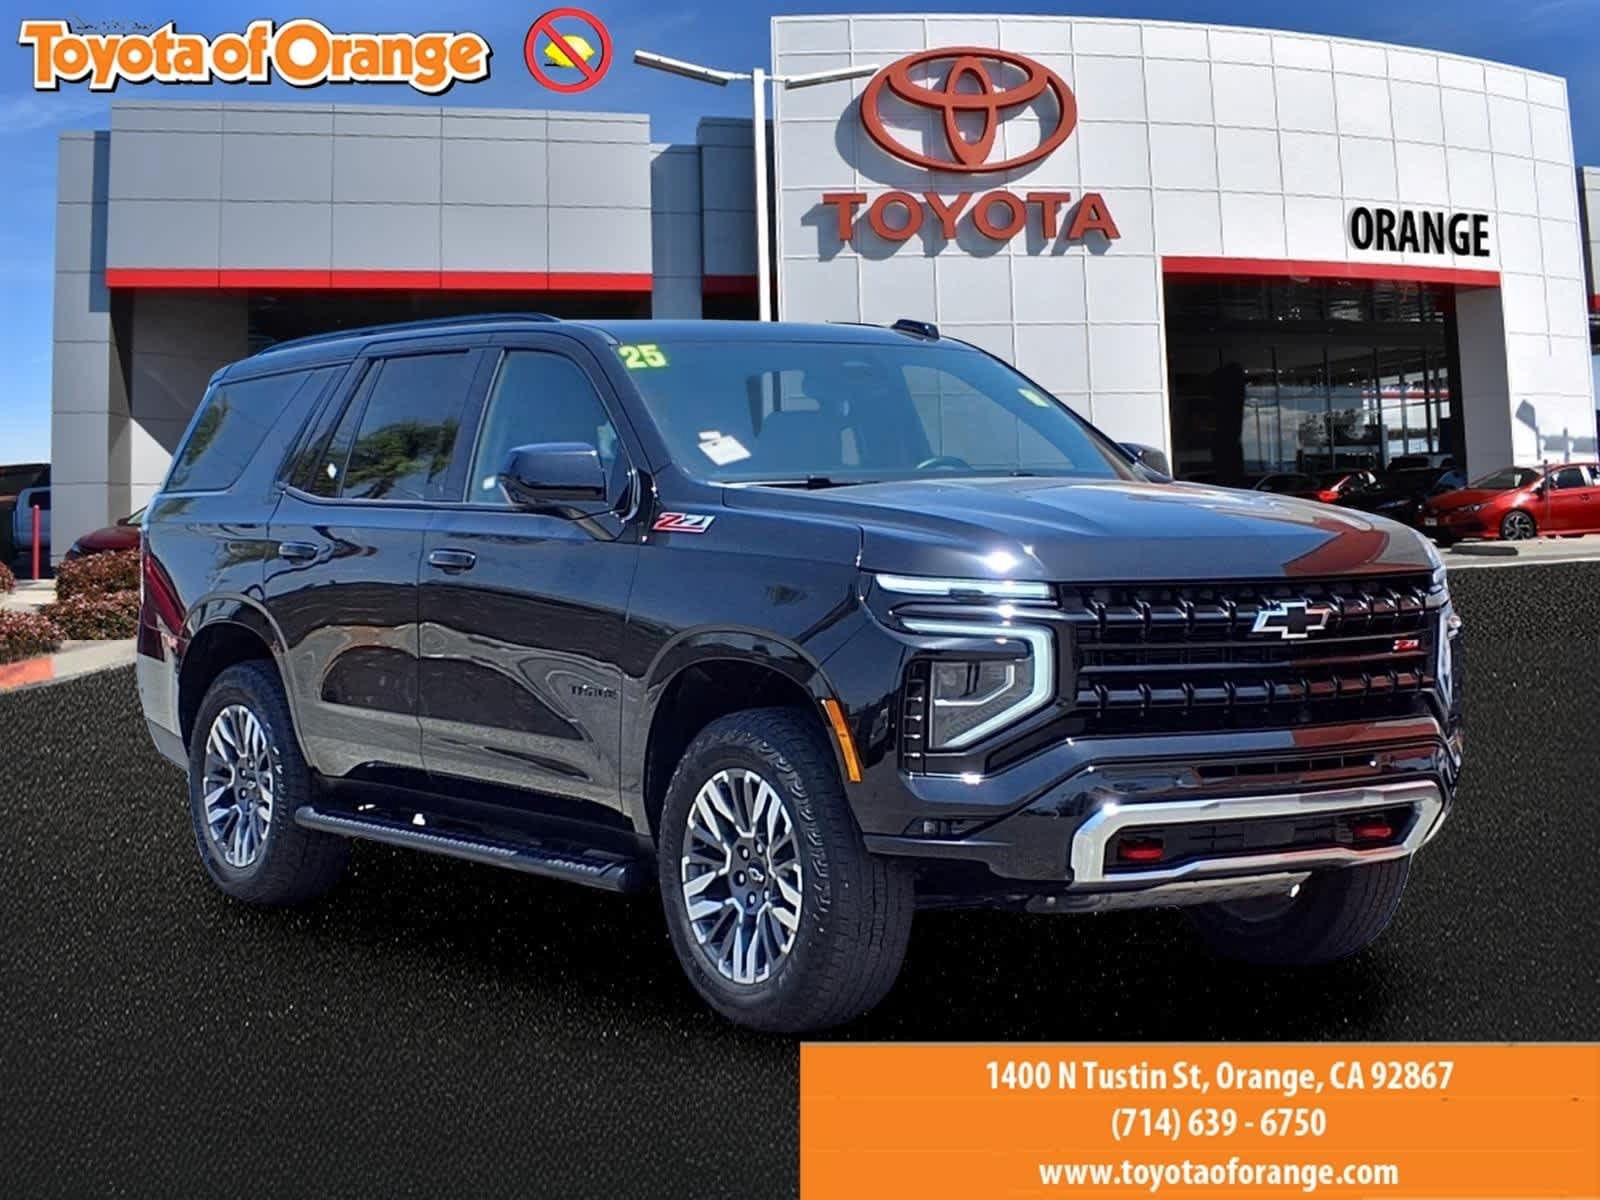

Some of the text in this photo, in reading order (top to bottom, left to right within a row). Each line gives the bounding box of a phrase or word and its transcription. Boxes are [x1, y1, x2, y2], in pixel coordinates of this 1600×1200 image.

[823, 190, 1121, 241] TOYOTA
[1350, 206, 1491, 258] ORANGE
[618, 344, 667, 369] 25
